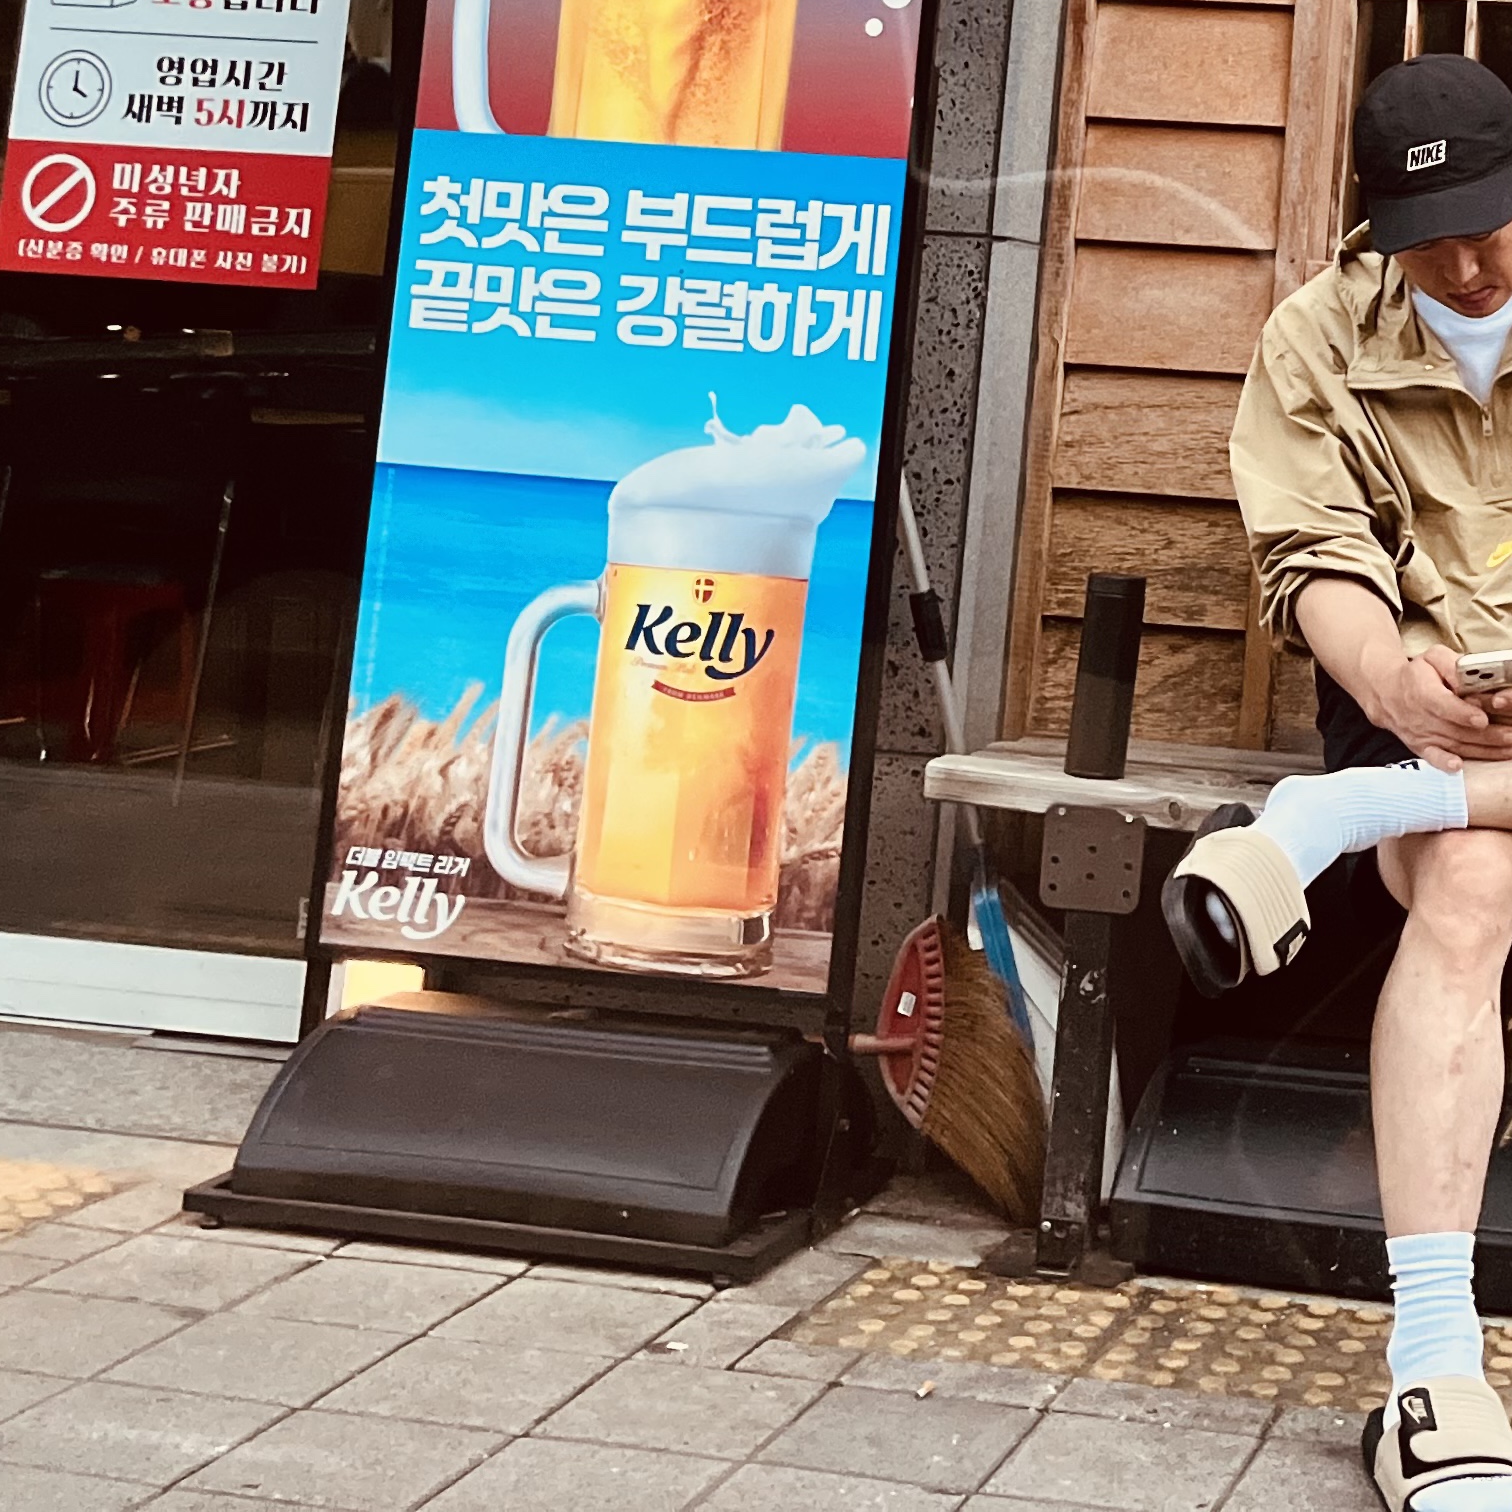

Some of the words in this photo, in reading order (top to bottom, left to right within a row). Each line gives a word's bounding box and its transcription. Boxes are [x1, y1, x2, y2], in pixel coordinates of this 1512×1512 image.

[156, 56, 289, 92] 영업시간
[121, 93, 185, 125] 새벽
[194, 98, 310, 132] 5시까지
[1409, 142, 1443, 168] NIKE
[112, 162, 242, 199] 미성년자
[109, 197, 171, 230] 주류
[183, 201, 312, 239] 판매금지
[419, 175, 610, 257] 첫맛은
[620, 189, 892, 276] 부드럽게
[90, 243, 129, 264] 확인
[151, 247, 207, 270] 휴대폰
[214, 250, 253, 272] 사진
[408, 259, 602, 343] 끝맛은
[616, 274, 883, 362] 강렬하게
[624, 604, 775, 681] Kelly
[330, 870, 466, 940] Kelly
